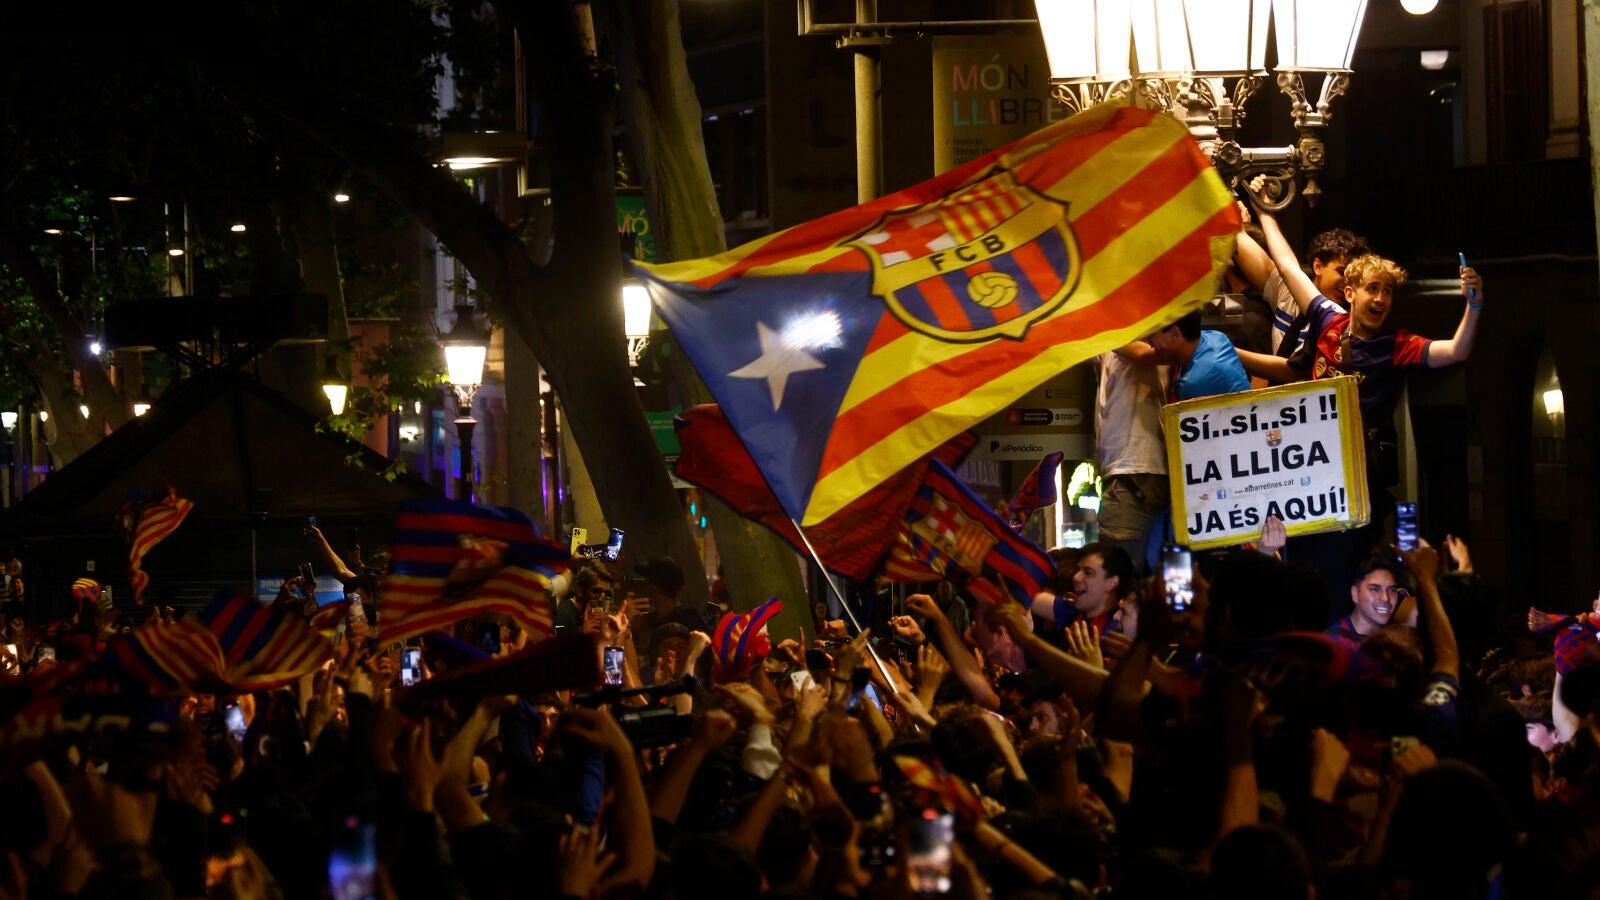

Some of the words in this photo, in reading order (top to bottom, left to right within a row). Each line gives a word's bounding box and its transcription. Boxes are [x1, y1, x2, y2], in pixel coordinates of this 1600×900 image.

[952, 53, 1029, 92] MÓN
[952, 98, 1065, 126] LLIBRE
[1185, 460, 1222, 485] LA
[1230, 440, 1330, 478] LLIGA
[1187, 510, 1226, 535] JA
[1228, 503, 1260, 530] ÉS
[1264, 486, 1346, 522] AQUÍ!
